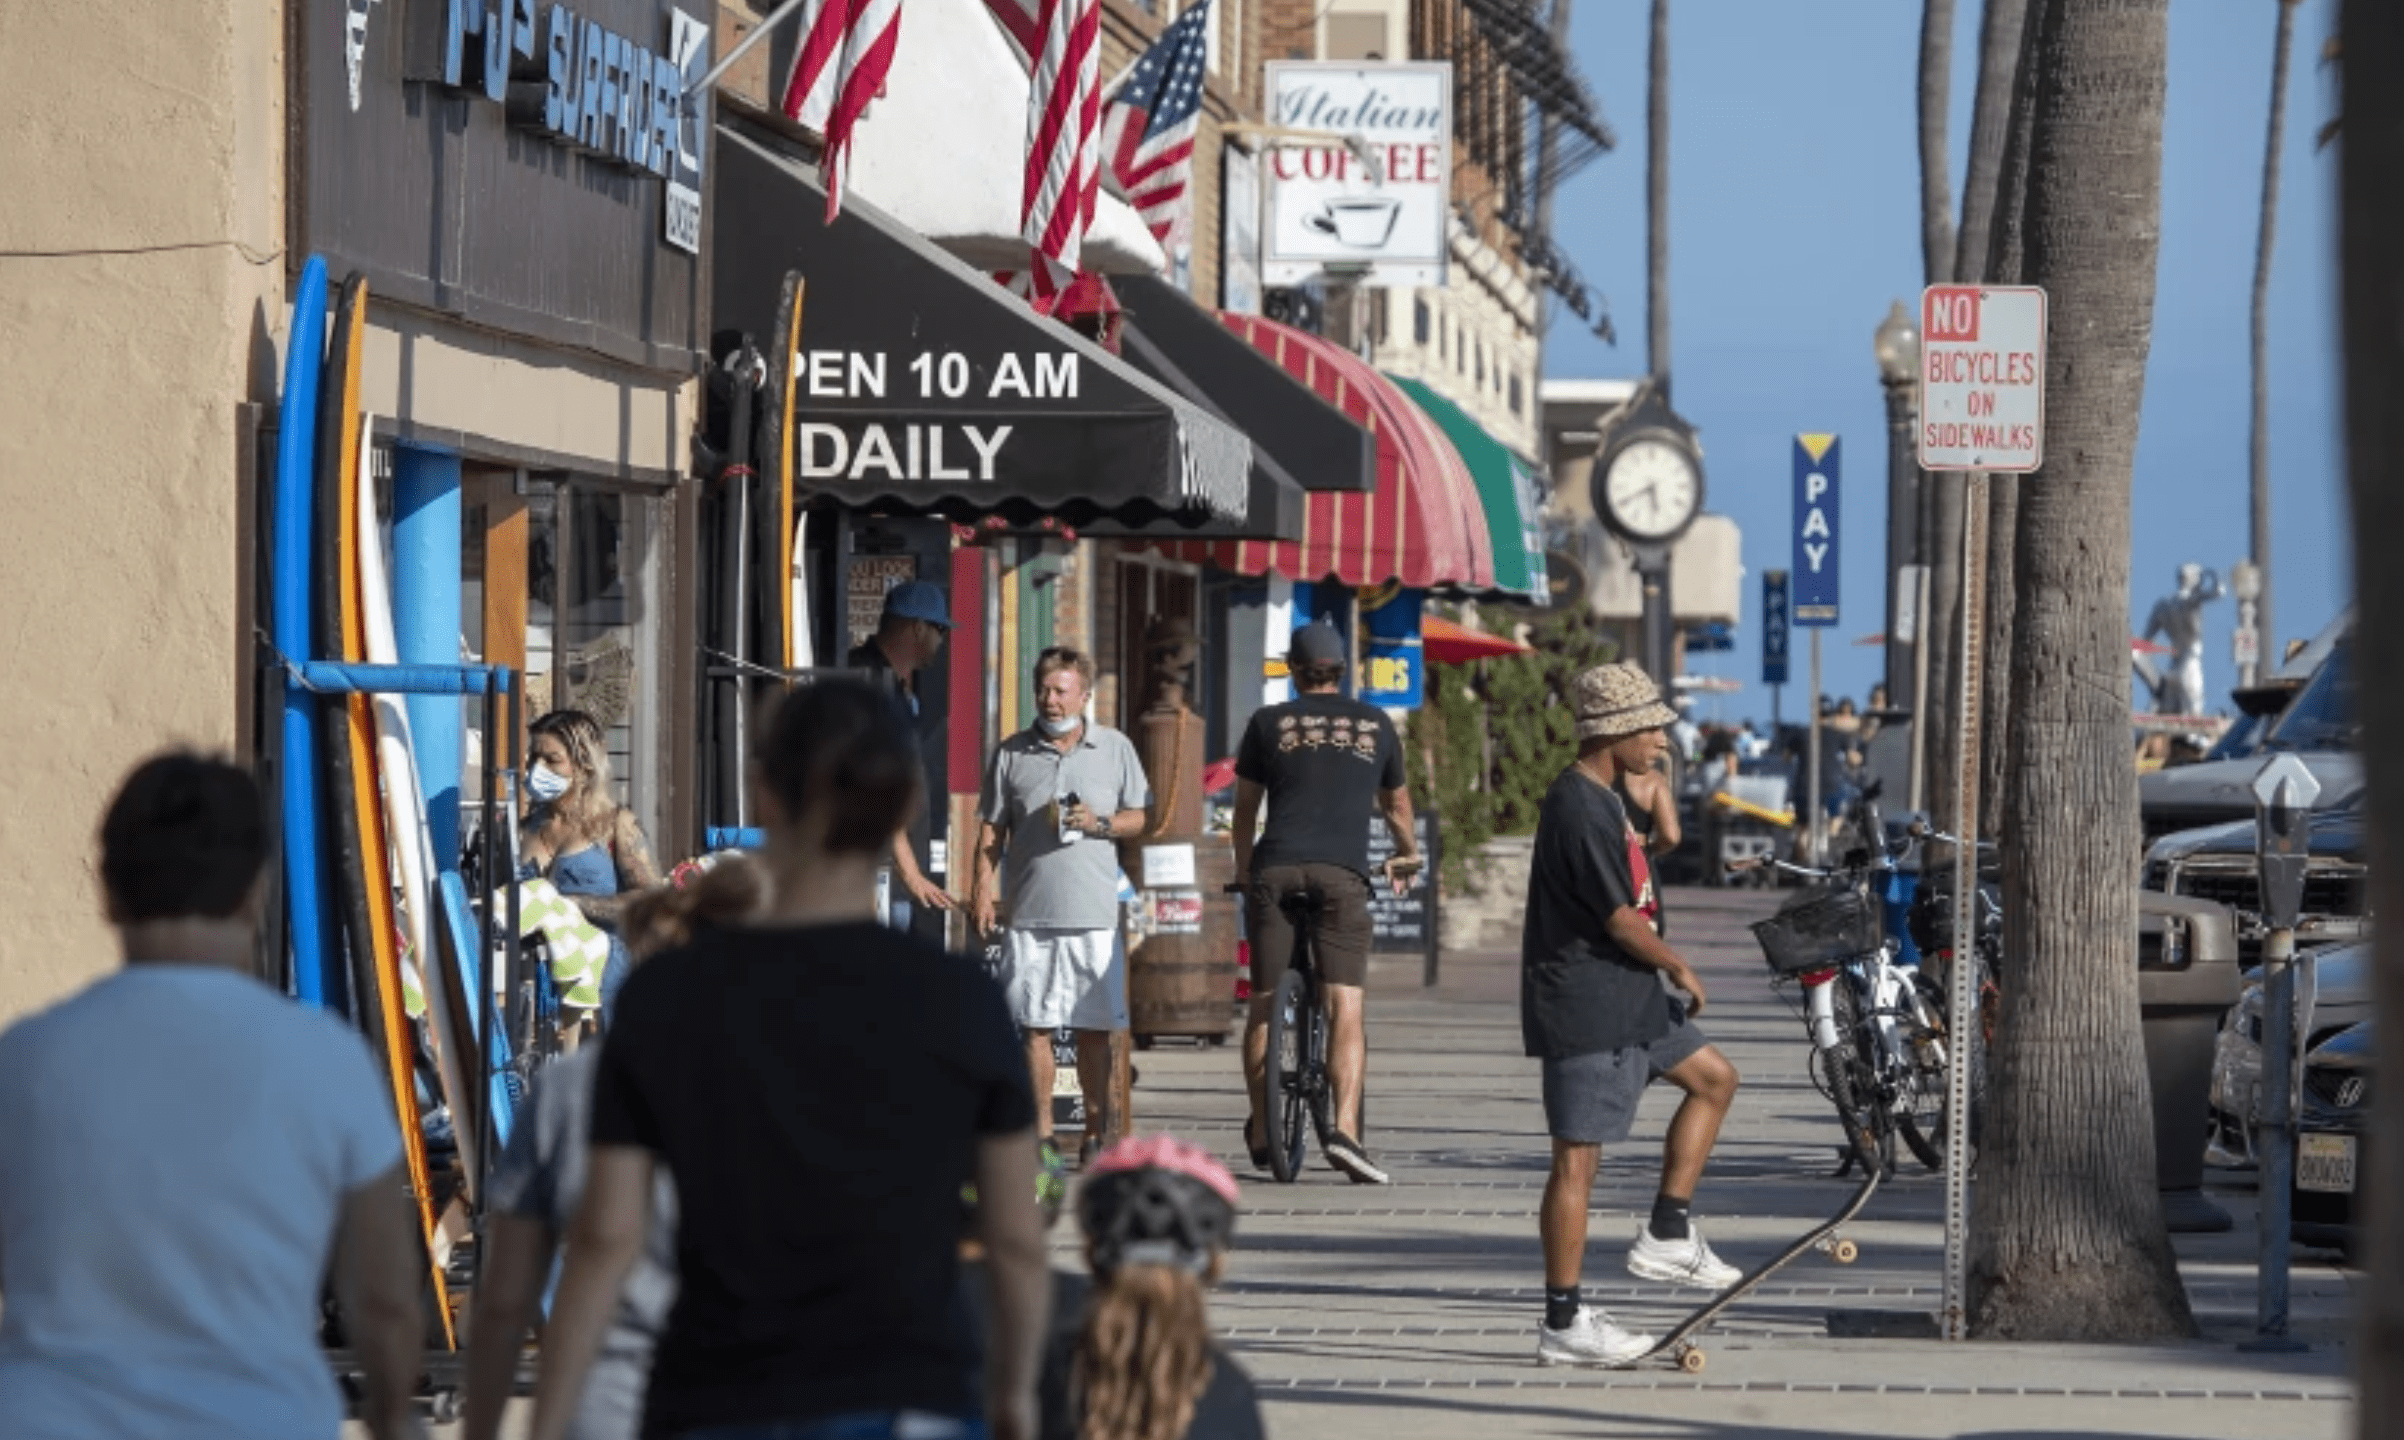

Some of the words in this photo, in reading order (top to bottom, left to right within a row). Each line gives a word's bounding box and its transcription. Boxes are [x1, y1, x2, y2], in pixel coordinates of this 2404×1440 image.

[1283, 86, 1441, 128] Italian
[1932, 294, 1972, 334] NO
[909, 351, 970, 399] 10
[987, 352, 1079, 399] AM
[1928, 352, 2035, 385] BICYCLES
[1967, 390, 1995, 417] ON
[800, 422, 1014, 480] DAILY
[1926, 422, 2034, 450] SIDEWALKS
[1802, 472, 1831, 574] PAY
